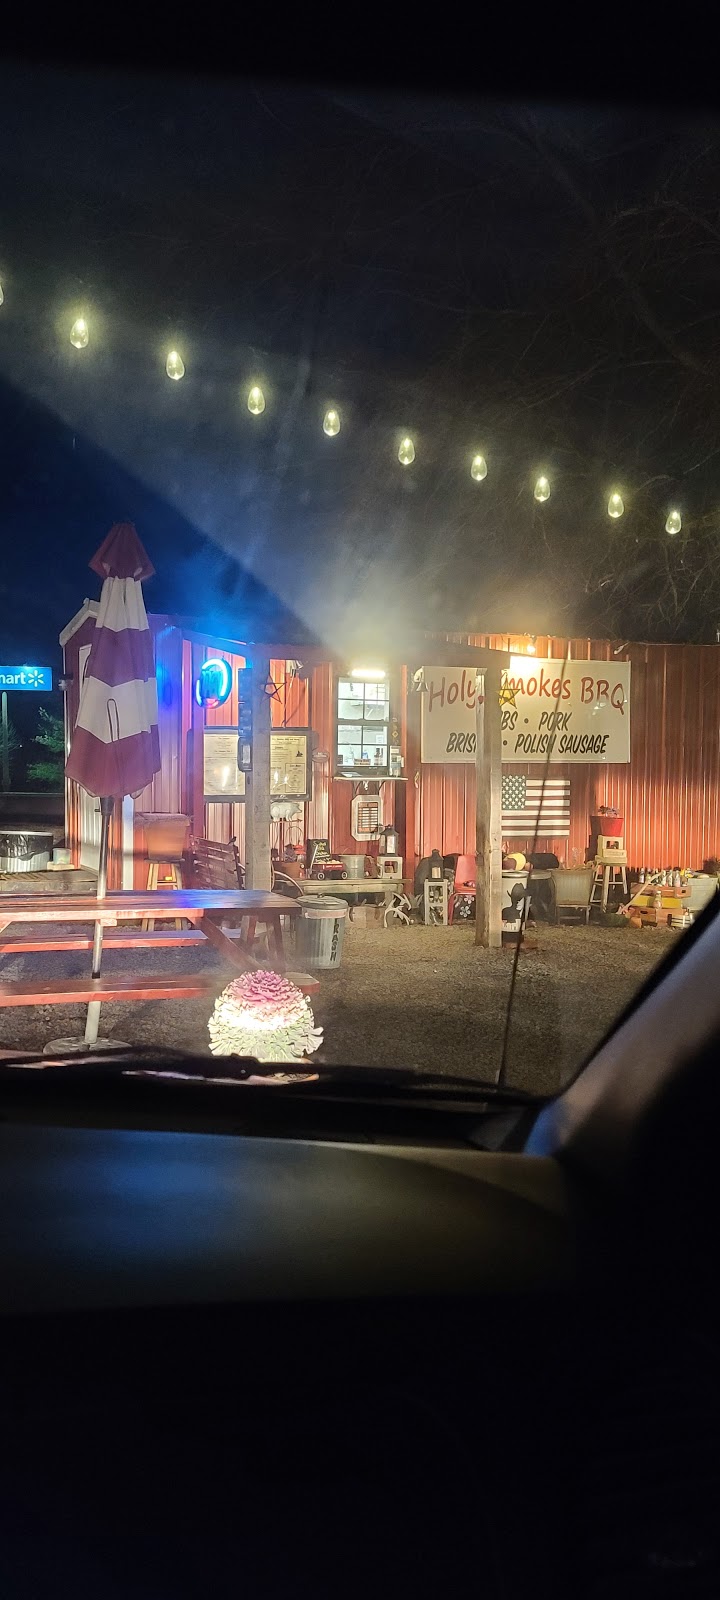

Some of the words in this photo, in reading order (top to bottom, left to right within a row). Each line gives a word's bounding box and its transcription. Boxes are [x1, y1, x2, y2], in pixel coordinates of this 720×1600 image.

[428, 669, 476, 712] Holy
[508, 668, 569, 700] mokes
[580, 677, 624, 715] BBQ
[500, 710, 518, 730] BS
[538, 711, 572, 731] PORK
[446, 732, 476, 753] BRIS
[515, 733, 556, 754] POLISH
[558, 734, 609, 754] SAUSAGE
